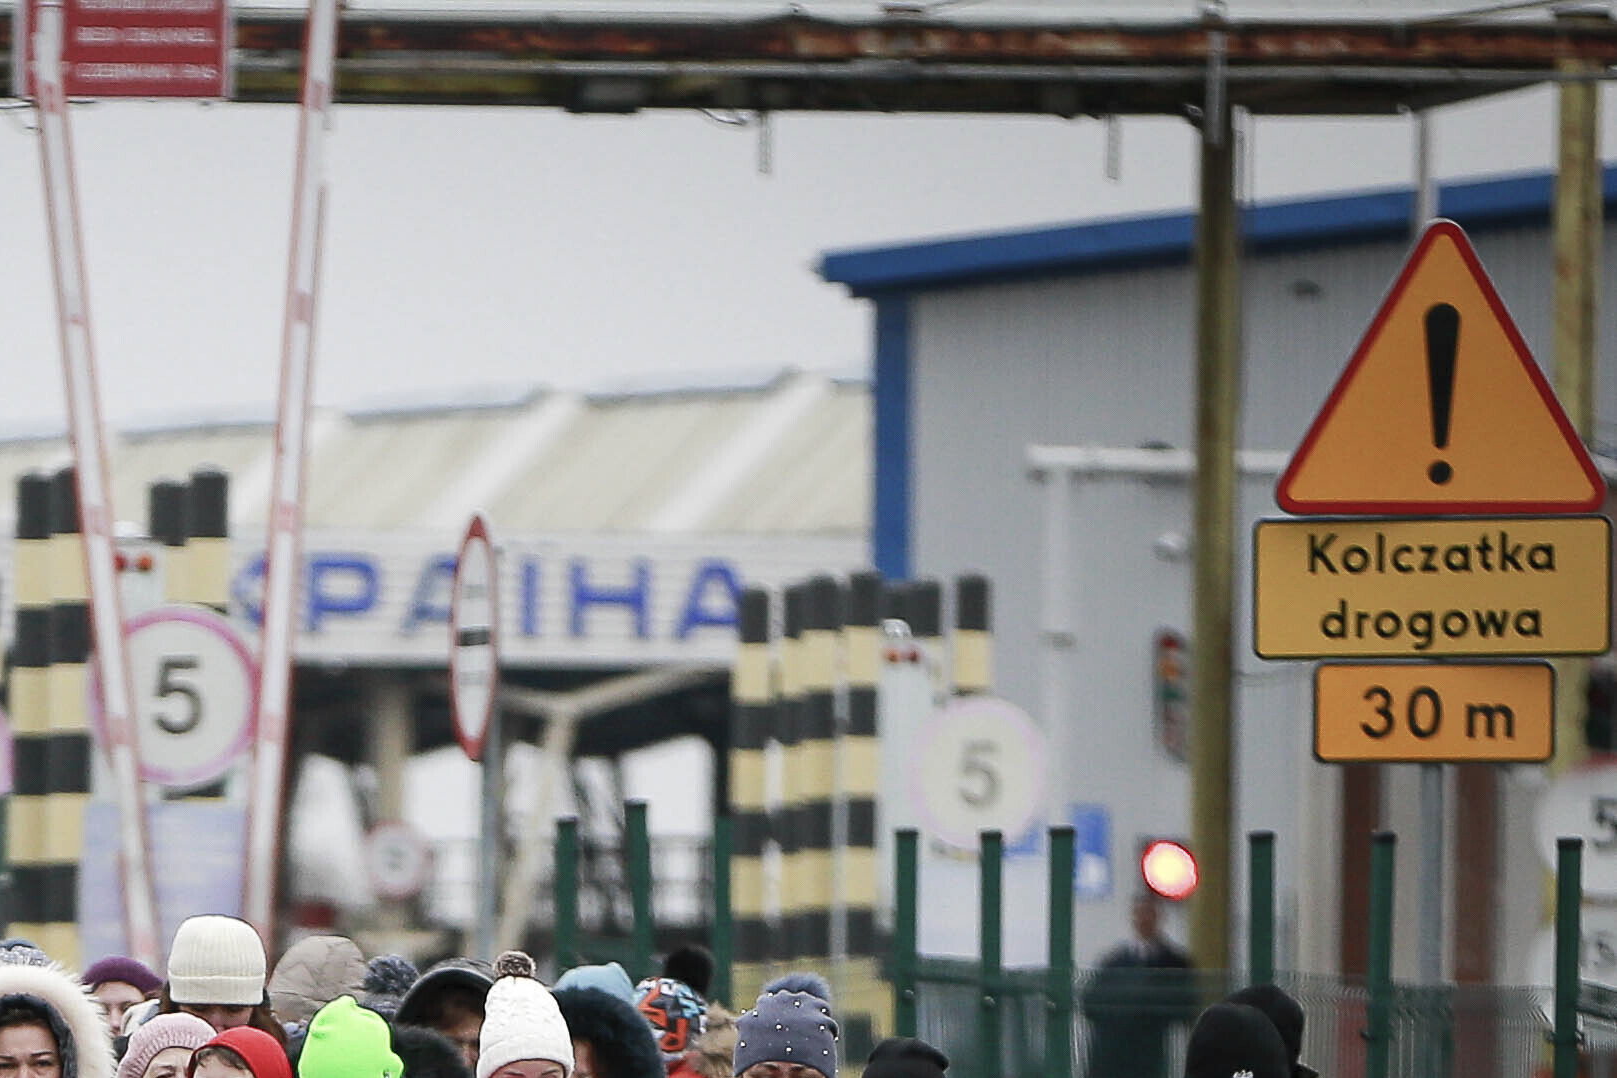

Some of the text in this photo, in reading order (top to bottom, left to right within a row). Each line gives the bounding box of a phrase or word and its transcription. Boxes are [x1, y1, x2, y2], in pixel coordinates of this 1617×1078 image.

[1306, 532, 1557, 574] Kolczatka
[1319, 599, 1543, 650] drogowa
[153, 655, 203, 734] 5
[1359, 685, 1516, 740] 30 m
[957, 739, 1003, 807] 5
